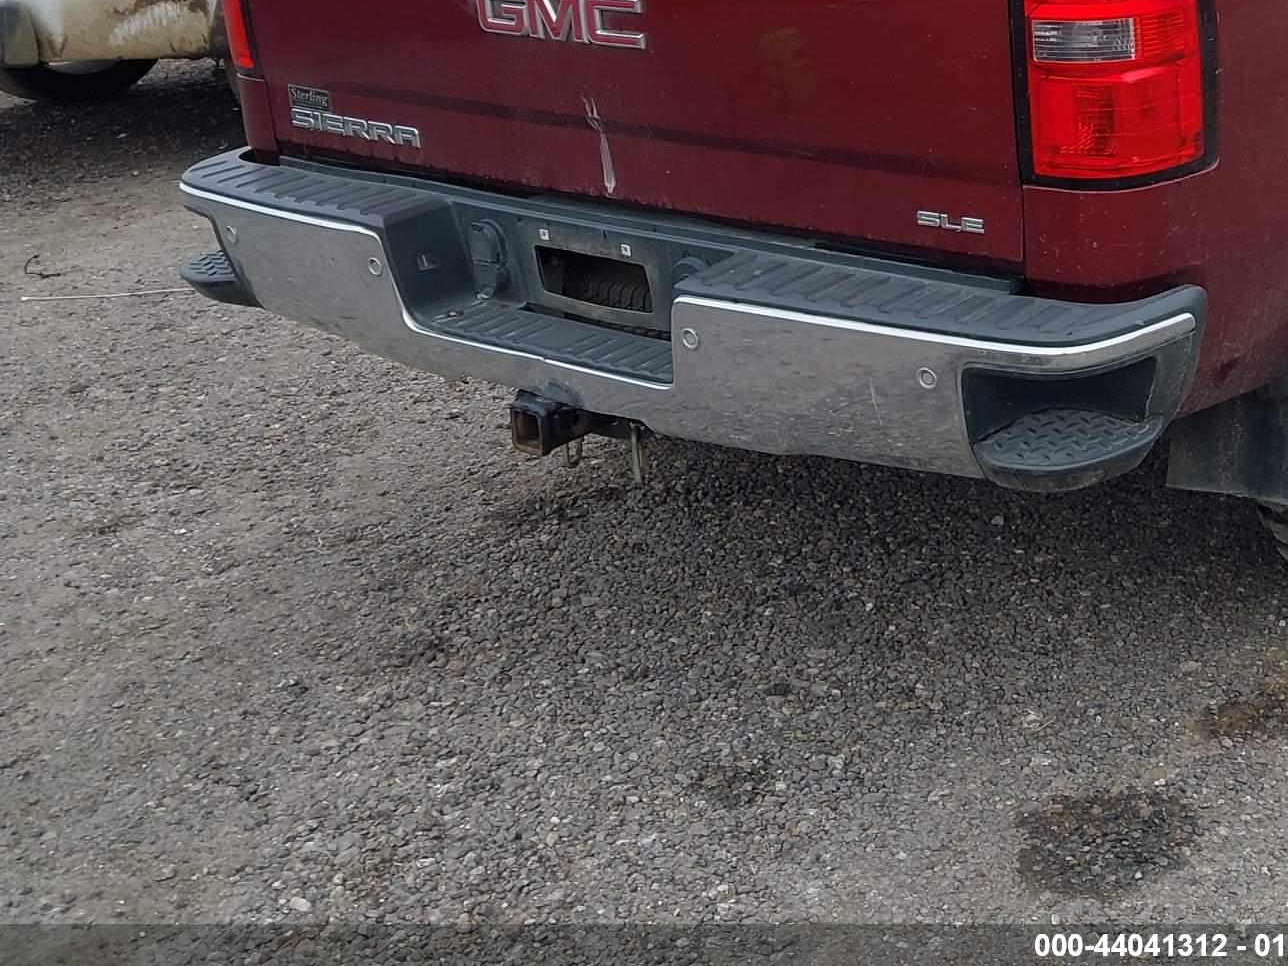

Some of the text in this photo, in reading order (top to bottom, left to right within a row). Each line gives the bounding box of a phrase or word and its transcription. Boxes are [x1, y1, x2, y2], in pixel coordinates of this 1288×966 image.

[290, 86, 329, 108] Sterling
[290, 107, 421, 149] SIERRA
[917, 210, 985, 234] SLE
